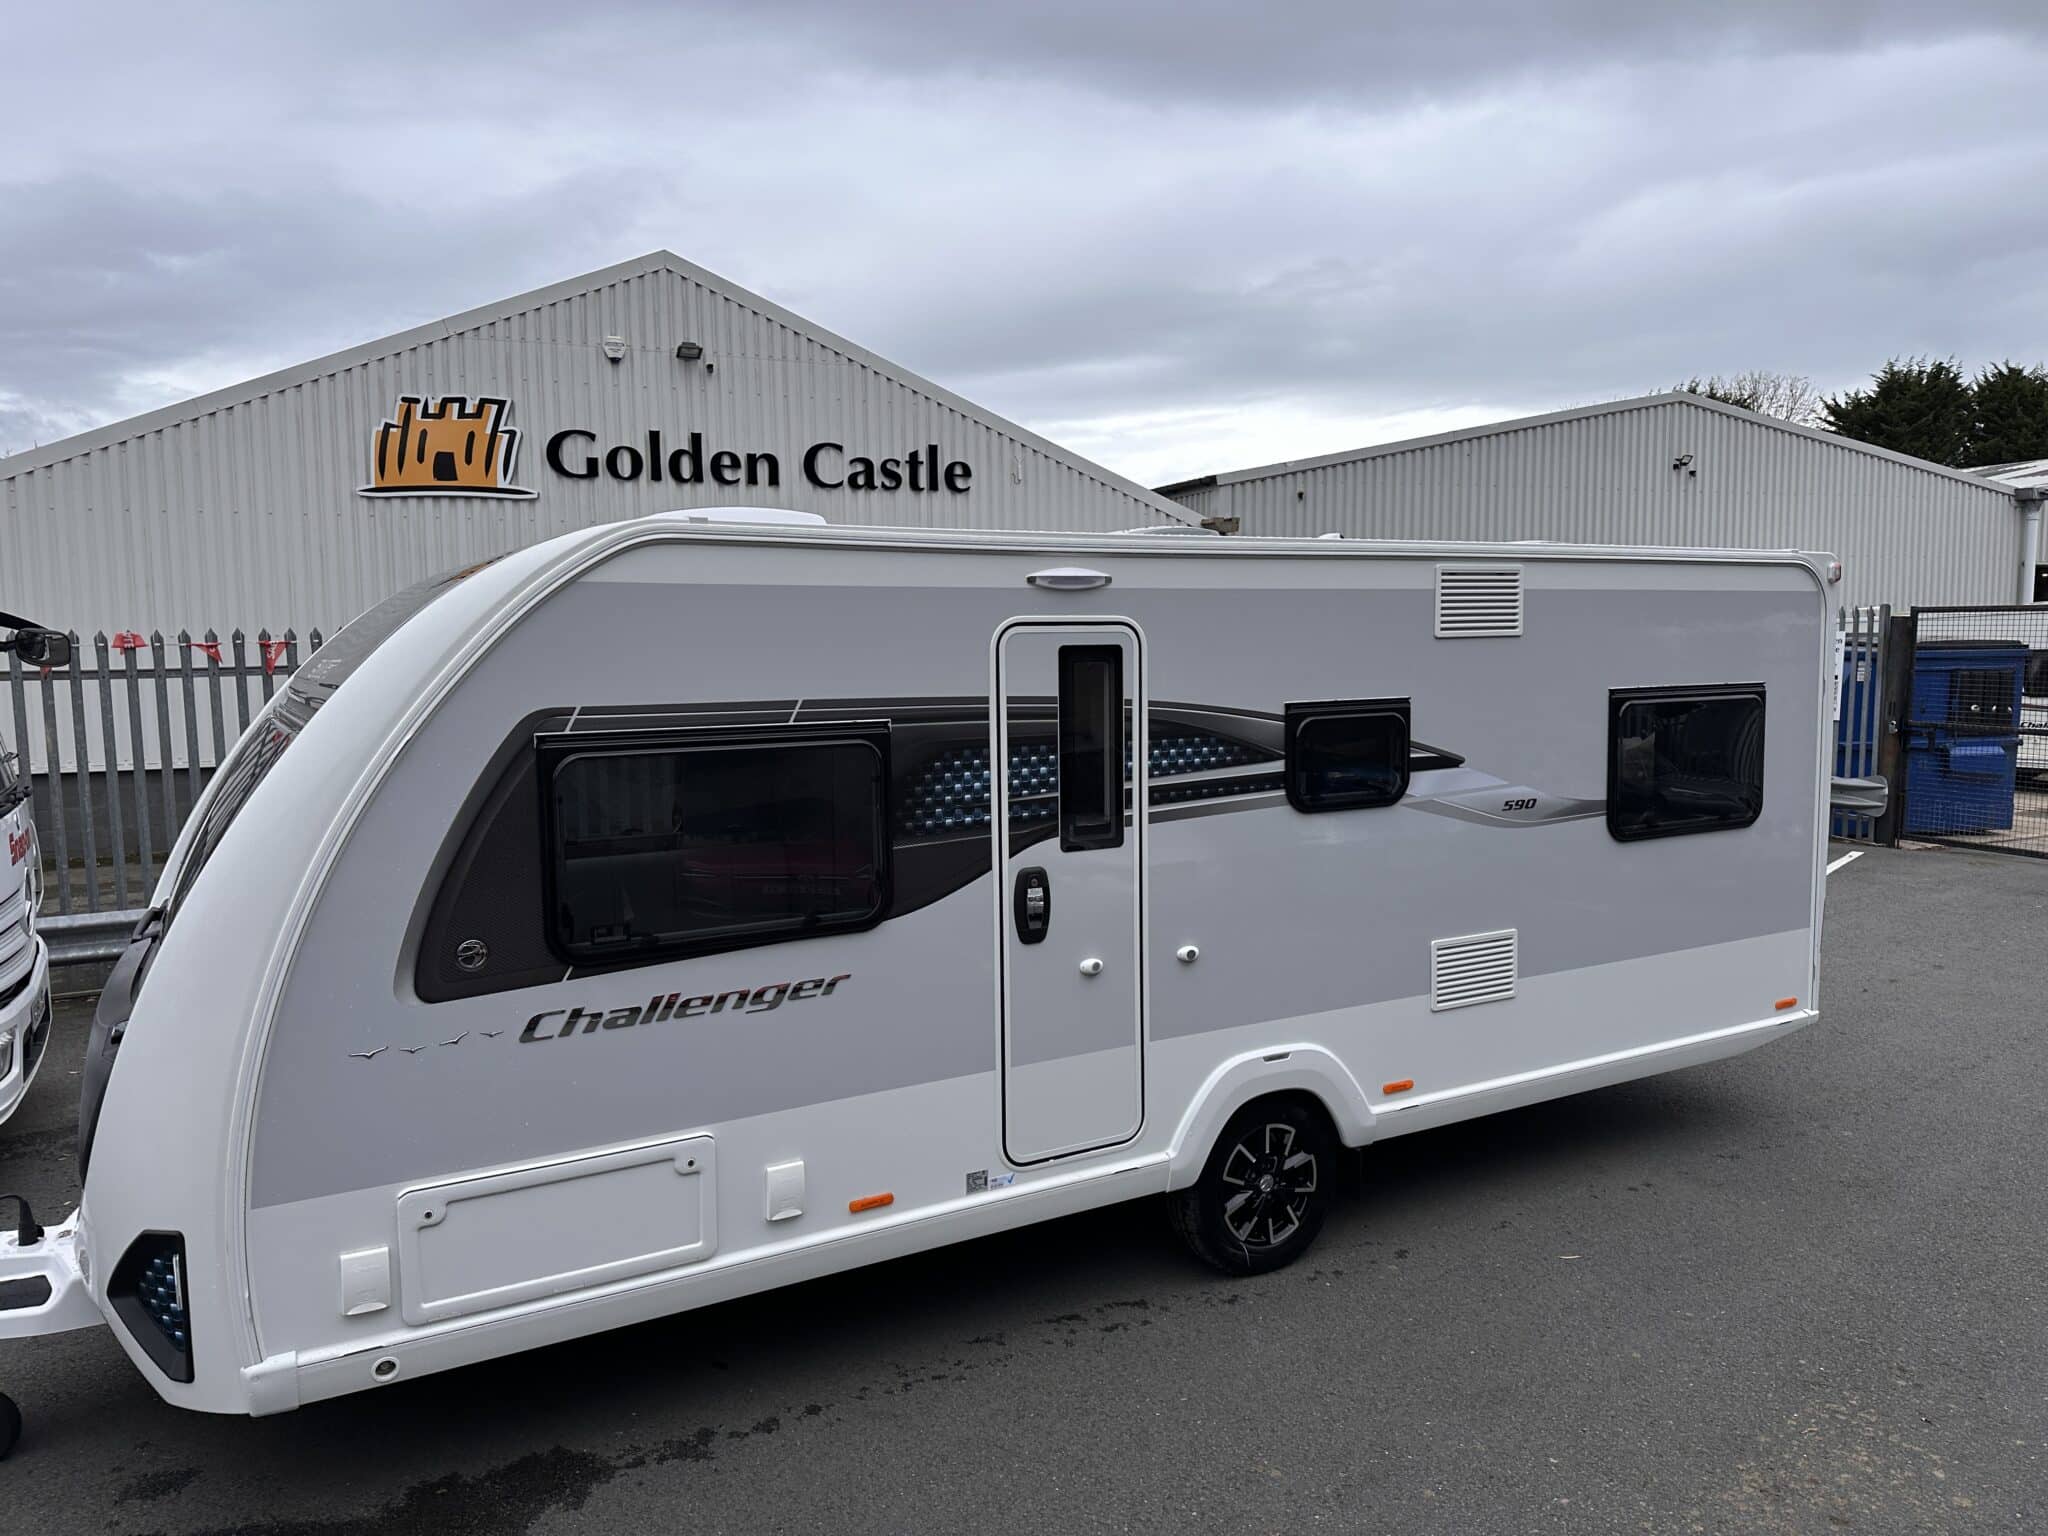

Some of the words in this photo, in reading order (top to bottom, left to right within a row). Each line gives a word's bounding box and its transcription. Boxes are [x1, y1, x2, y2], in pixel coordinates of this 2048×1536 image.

[545, 429, 781, 486] Golden
[803, 441, 973, 493] Castle
[1502, 798, 1538, 812] 590
[519, 973, 853, 1044] Challenger
